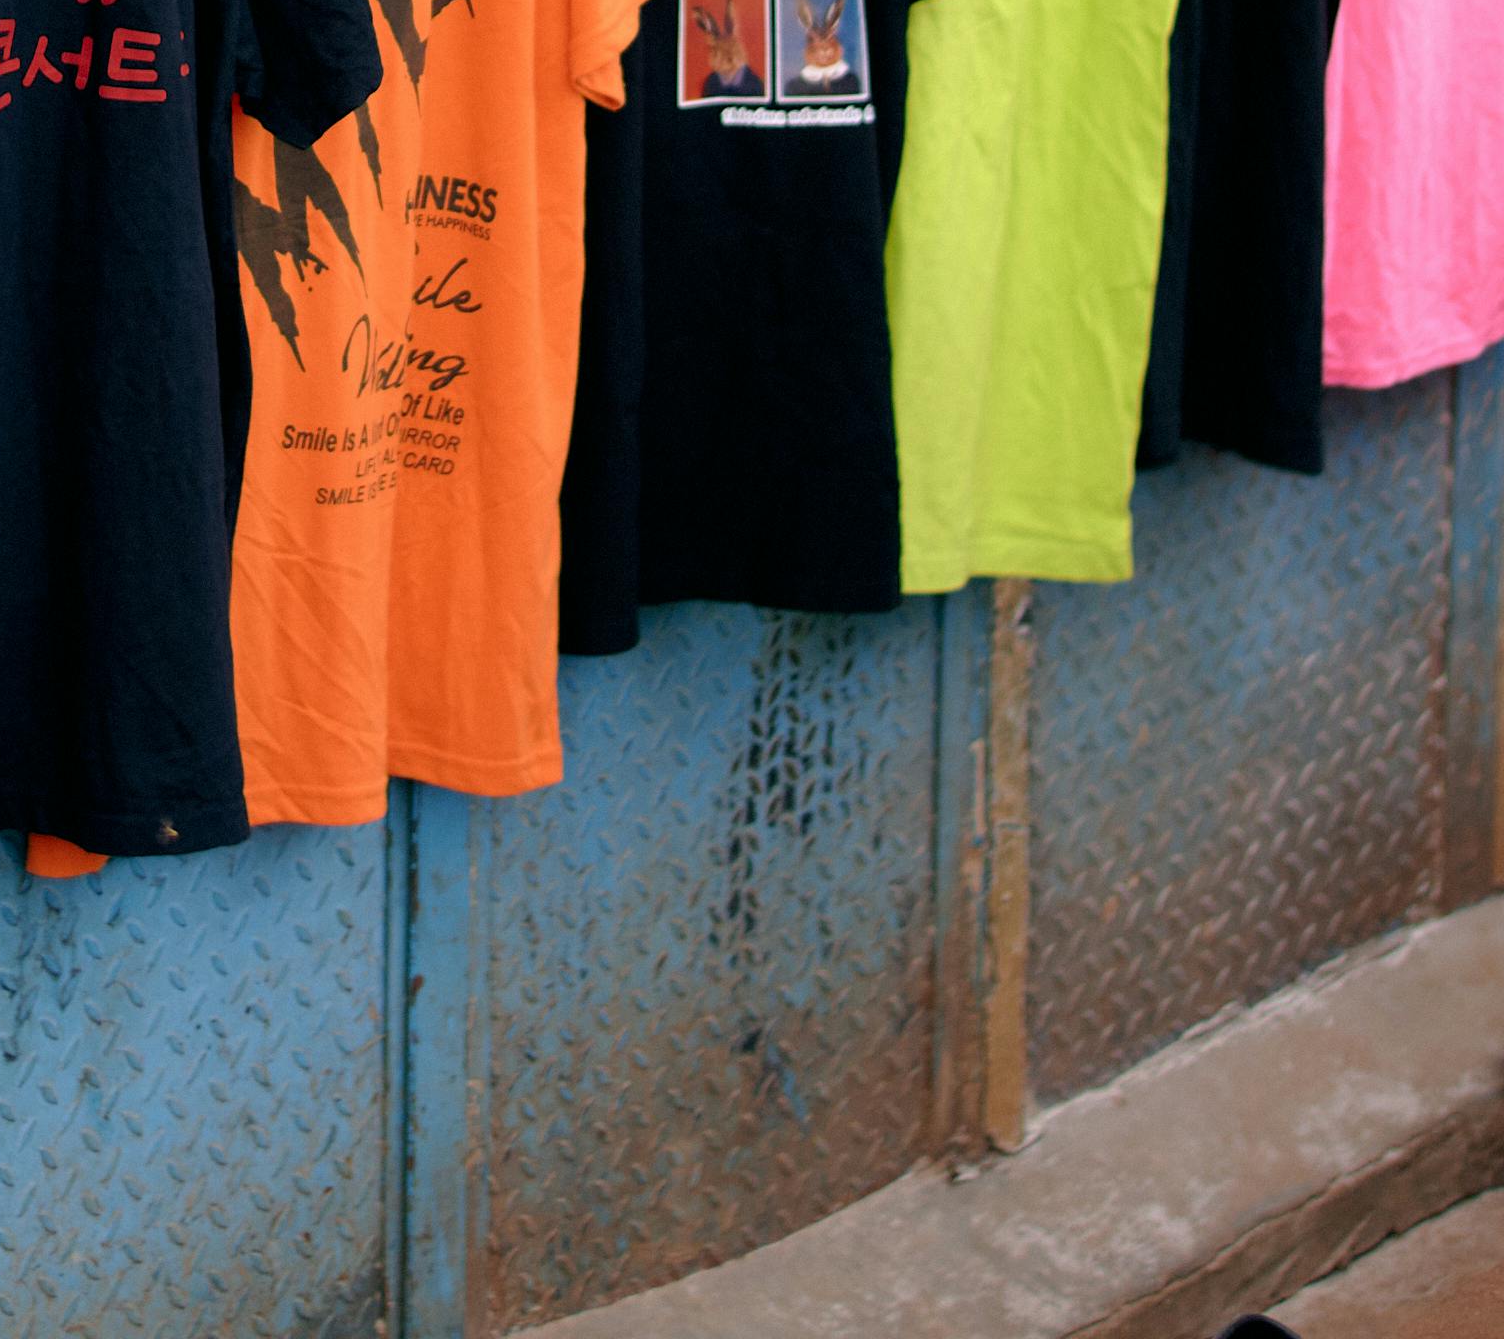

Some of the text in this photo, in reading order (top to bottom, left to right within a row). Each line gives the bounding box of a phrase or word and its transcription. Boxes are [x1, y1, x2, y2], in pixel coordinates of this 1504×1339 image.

[281, 424, 339, 453] Smile
[423, 395, 466, 426] Like
[402, 451, 456, 476] CARD
